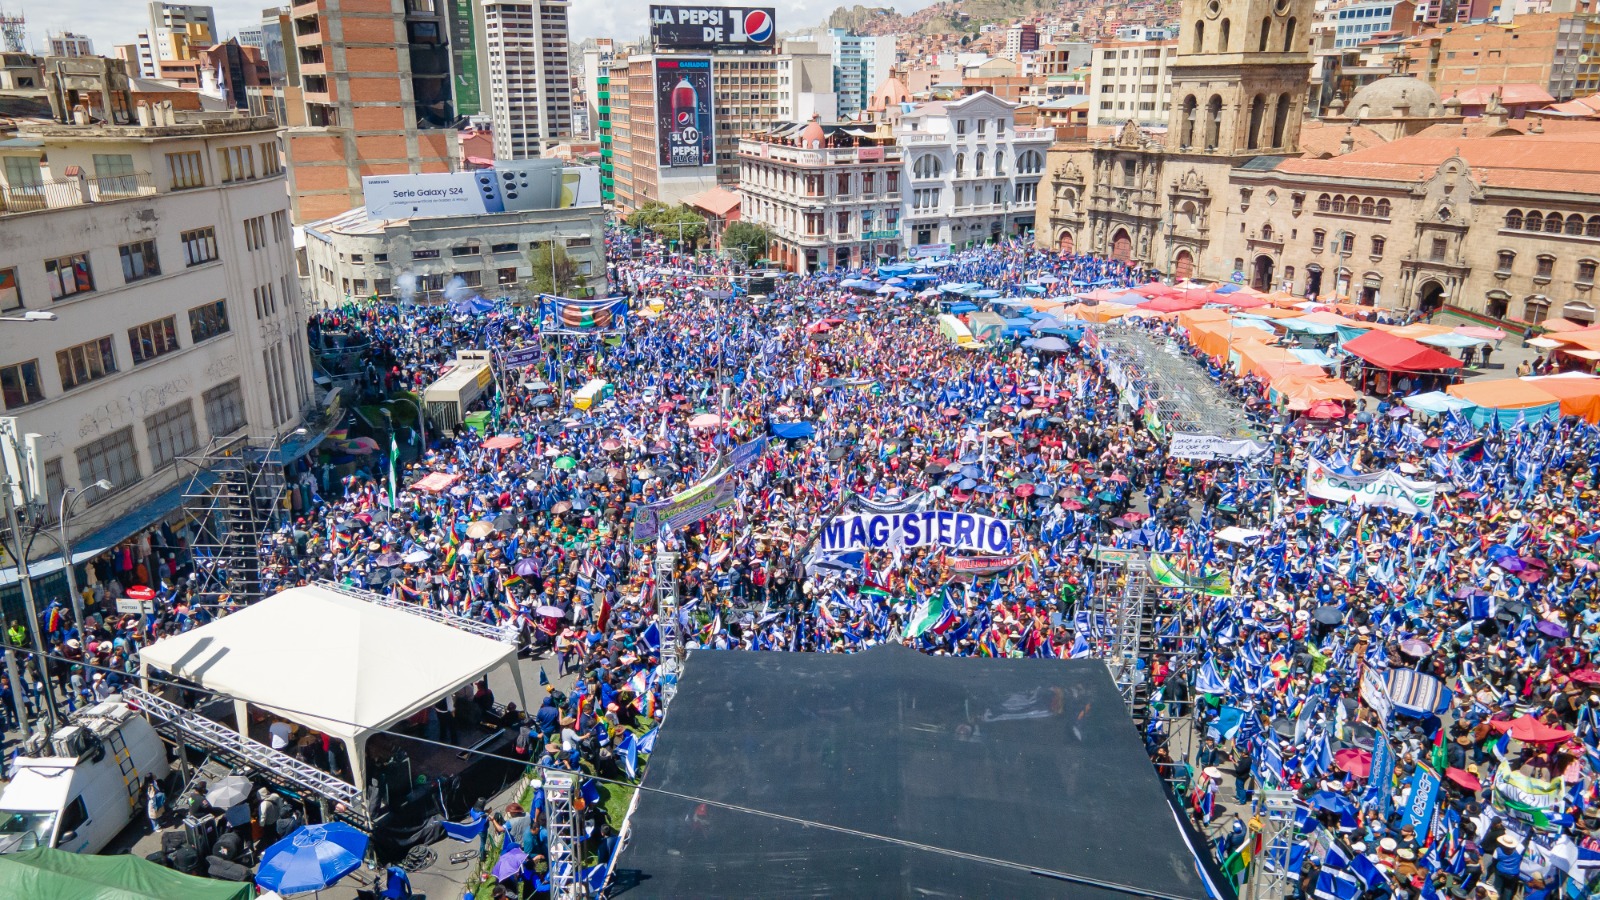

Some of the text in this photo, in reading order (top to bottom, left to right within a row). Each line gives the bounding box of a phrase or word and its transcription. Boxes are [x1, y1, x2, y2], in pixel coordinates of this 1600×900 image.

[654, 9, 723, 26] LA PEPSI
[703, 27, 723, 42] DE
[685, 130, 698, 141] 10
[672, 146, 699, 156] PEPSI
[673, 155, 699, 164] BLACK
[393, 187, 464, 198] Serie Galaxy S24
[1327, 477, 1410, 501] CAJUATA
[820, 511, 1008, 551] MAGISTERIO
